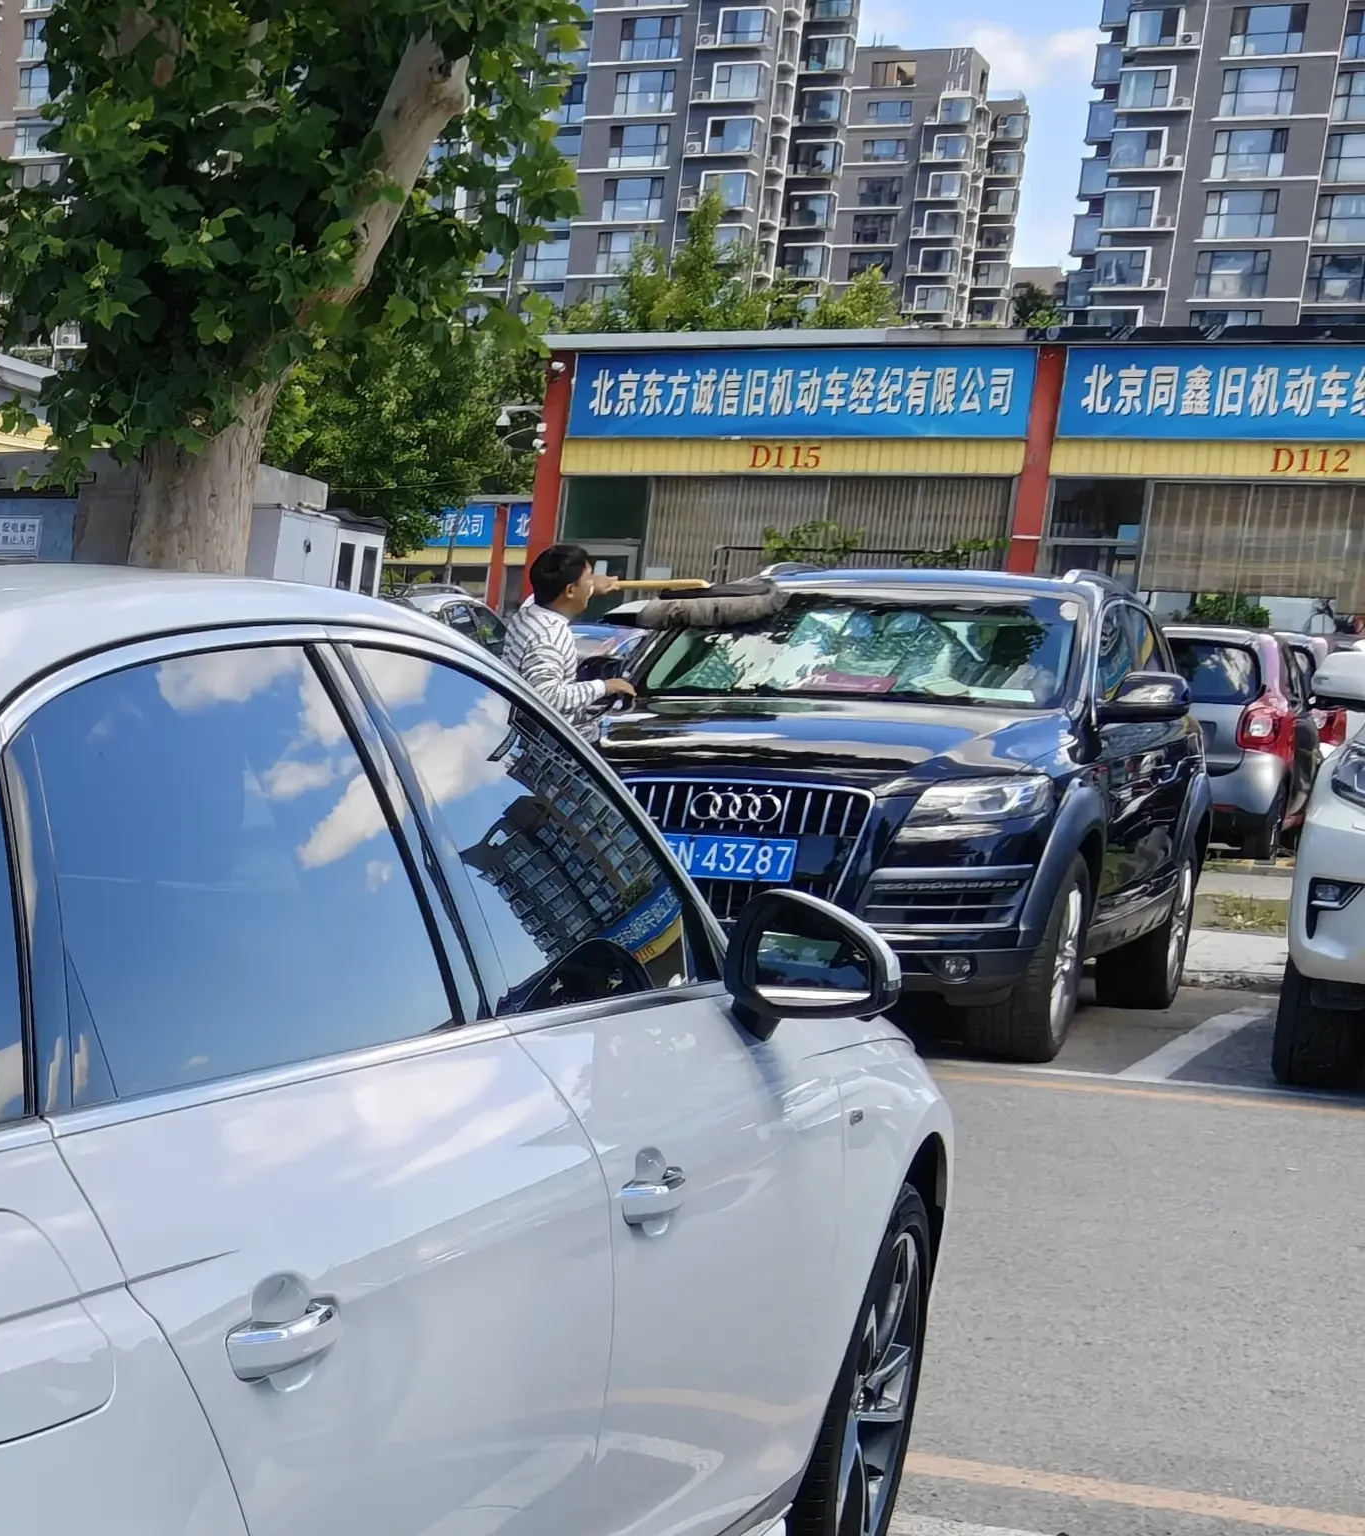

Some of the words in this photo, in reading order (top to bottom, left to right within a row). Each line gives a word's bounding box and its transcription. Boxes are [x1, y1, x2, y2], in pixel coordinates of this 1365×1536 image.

[588, 366, 1015, 417] 北京东方诚信旧机动车经纪有限公司
[749, 445, 821, 471] D115
[1270, 447, 1352, 473] D112
